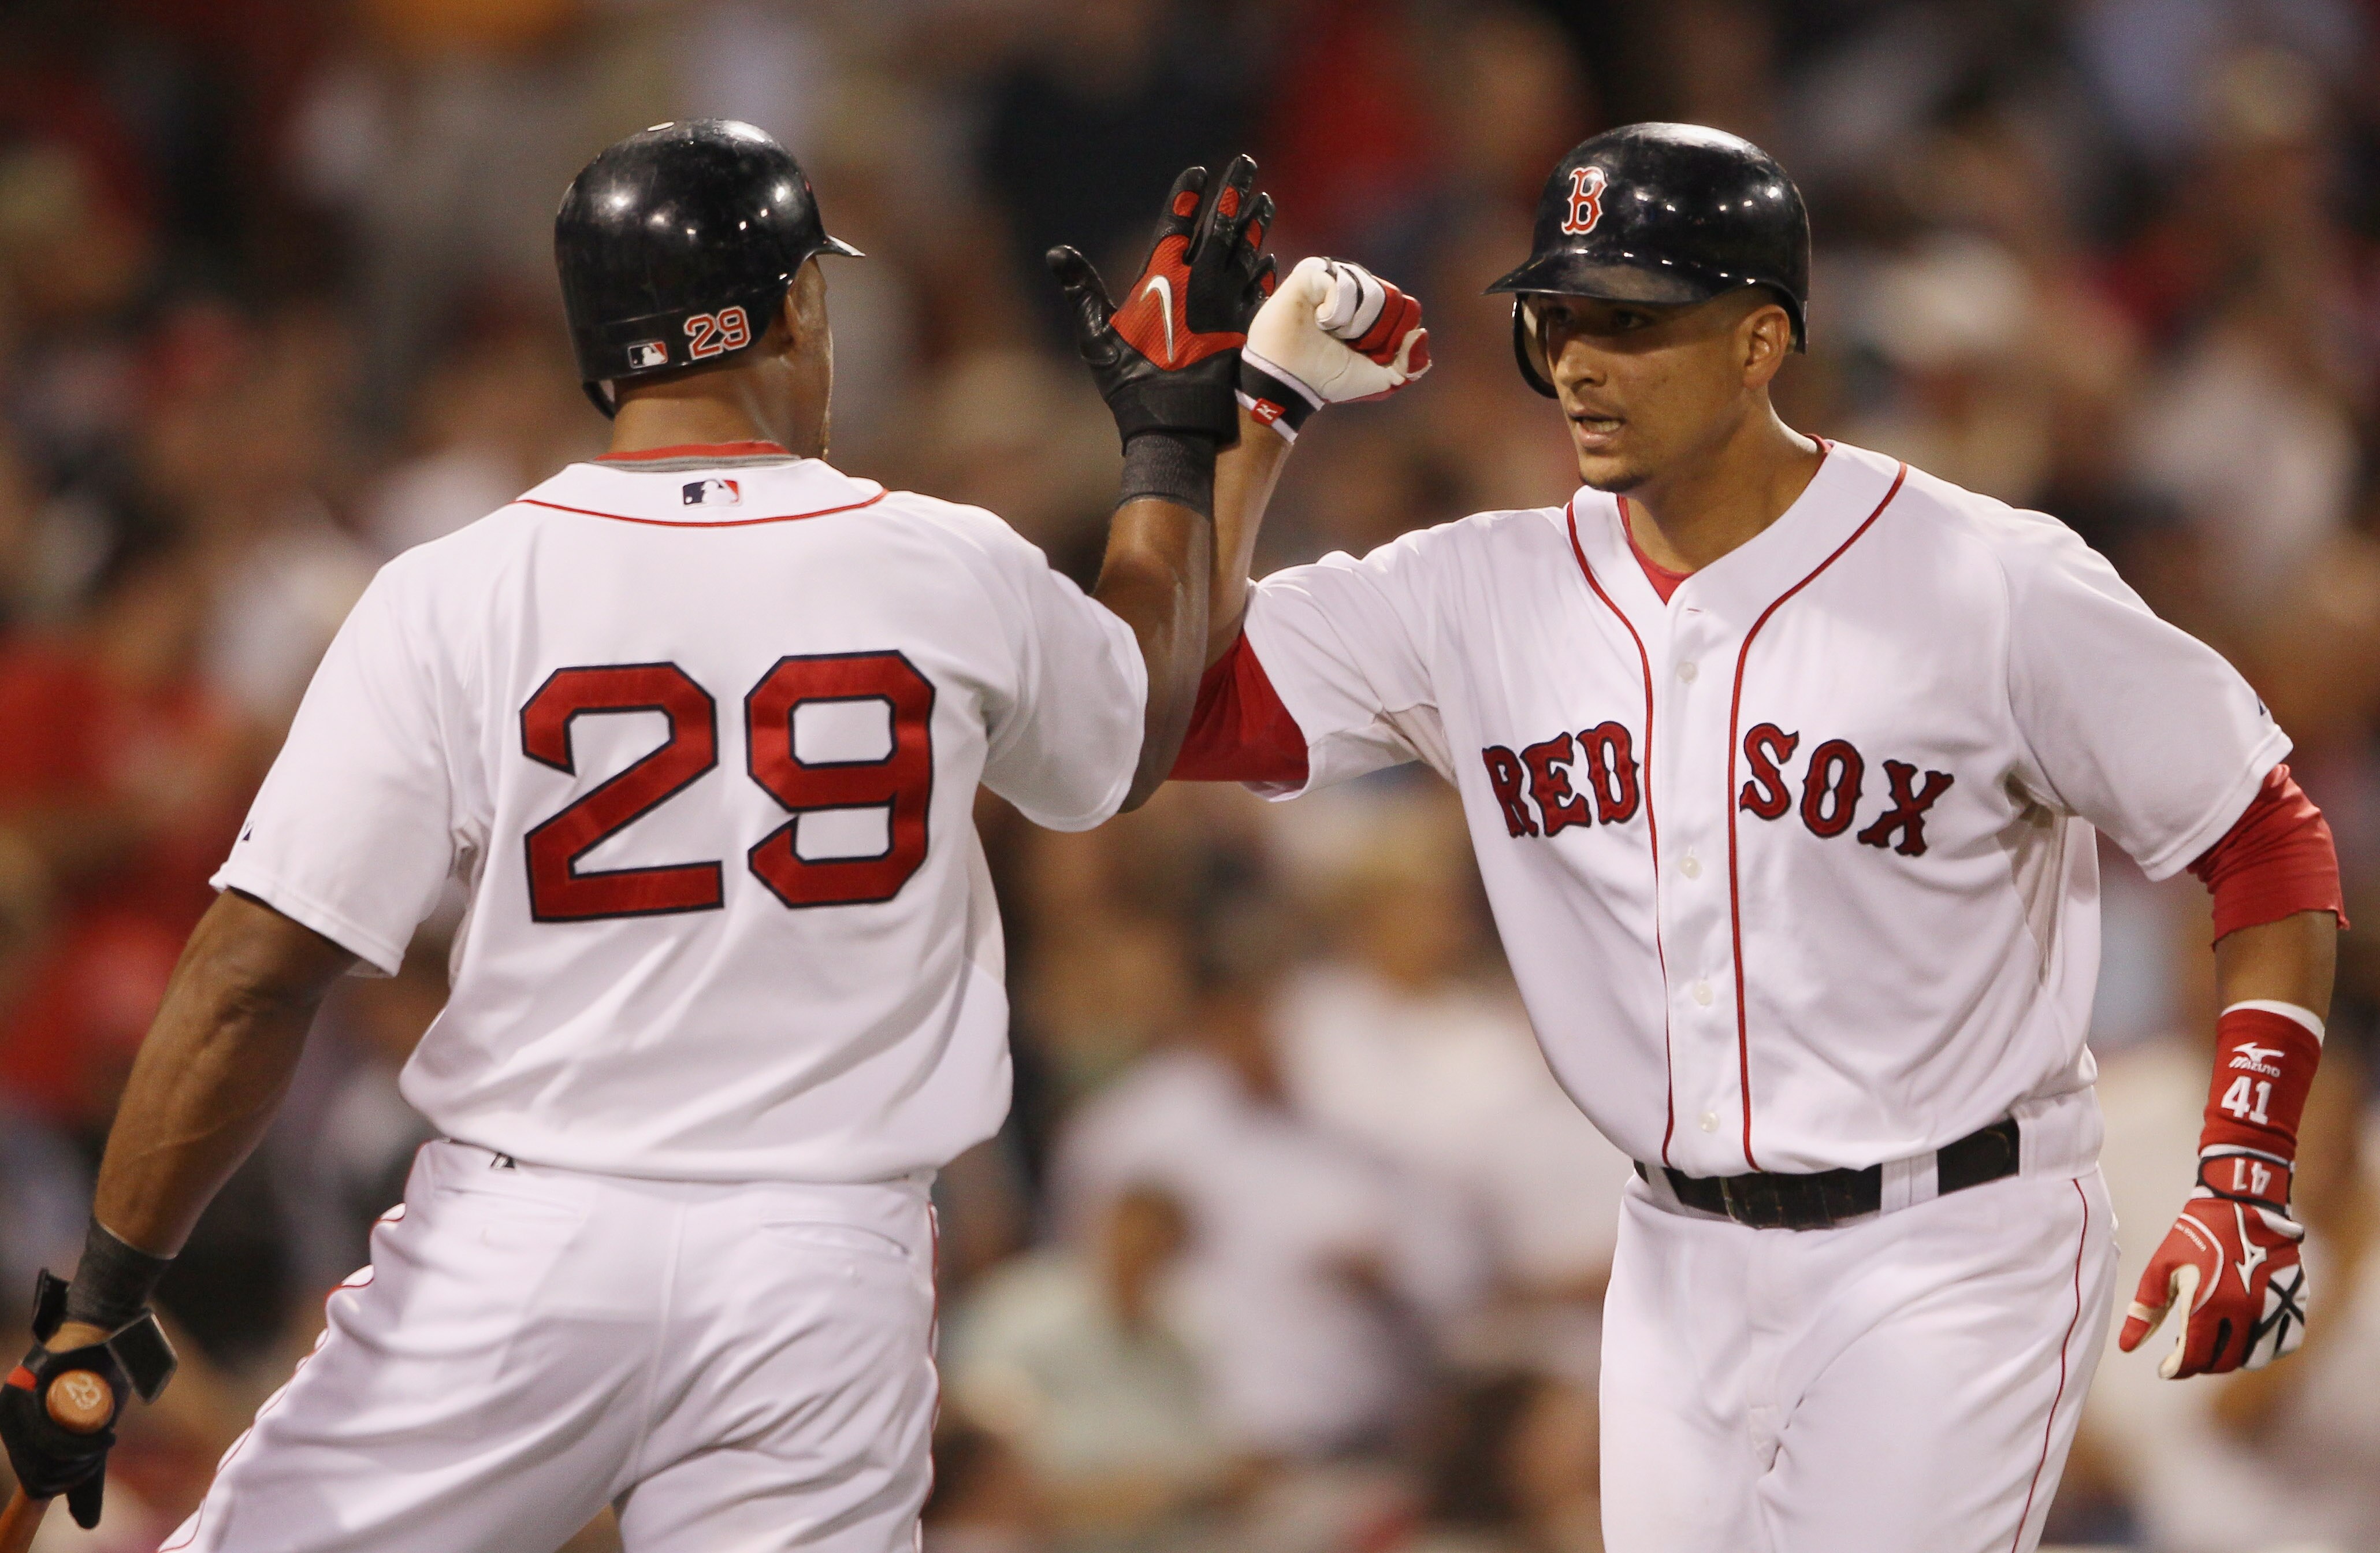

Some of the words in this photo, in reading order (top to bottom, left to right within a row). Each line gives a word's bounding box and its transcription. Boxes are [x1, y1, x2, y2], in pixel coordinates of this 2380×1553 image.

[1561, 166, 1608, 235] B
[683, 306, 751, 360] 29
[520, 649, 936, 922] 29
[1482, 721, 1639, 838] RED
[1740, 723, 1954, 856] SOX
[2221, 1075, 2273, 1125] 41
[2233, 1157, 2272, 1195] 41
[62, 1372, 102, 1410] 29
